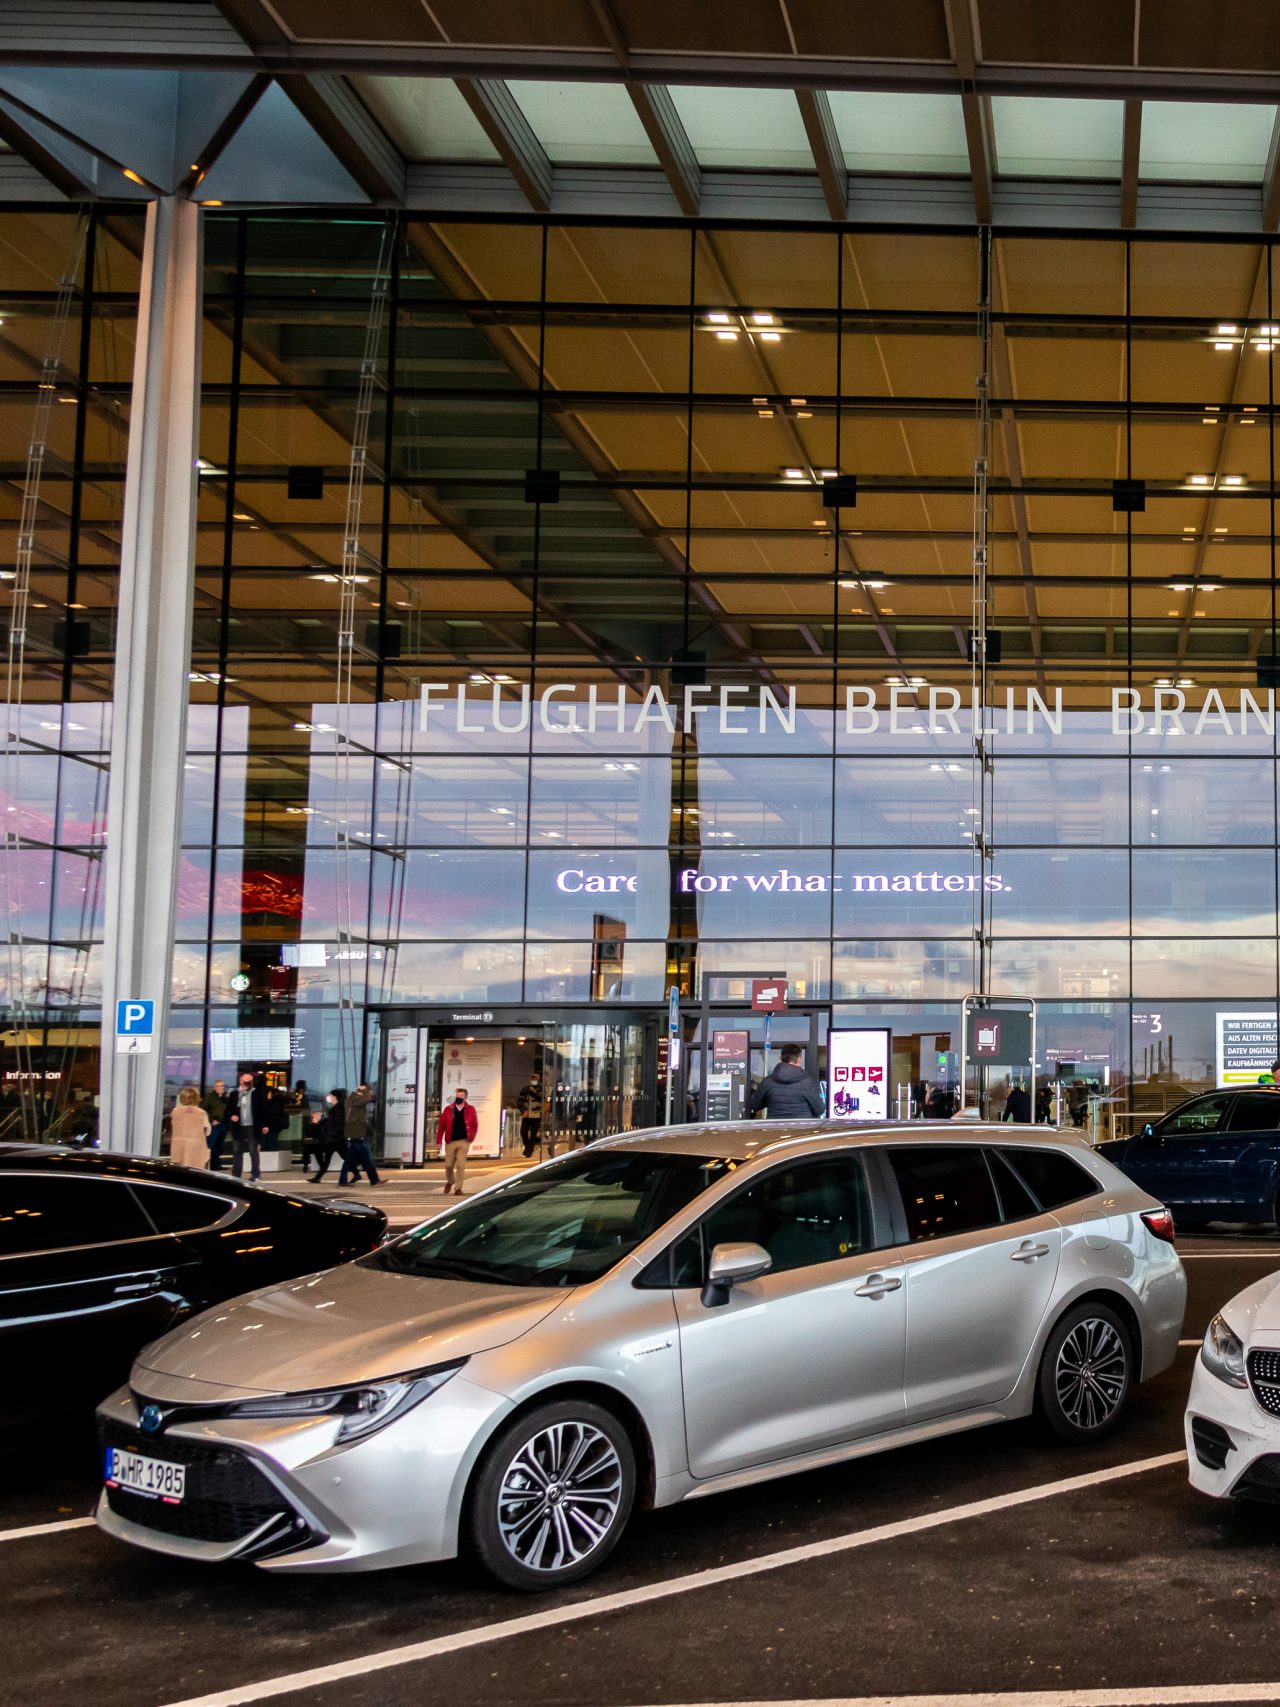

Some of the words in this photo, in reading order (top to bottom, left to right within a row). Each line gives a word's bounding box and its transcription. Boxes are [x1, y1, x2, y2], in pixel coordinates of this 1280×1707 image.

[420, 684, 796, 734] FLUGHAFEN
[846, 687, 1063, 735] BERLIN
[681, 869, 738, 892] for
[852, 872, 1012, 893] matters.
[125, 1004, 145, 1030] P
[1150, 1014, 1162, 1033] 3
[147, 1462, 183, 1494] 1985
